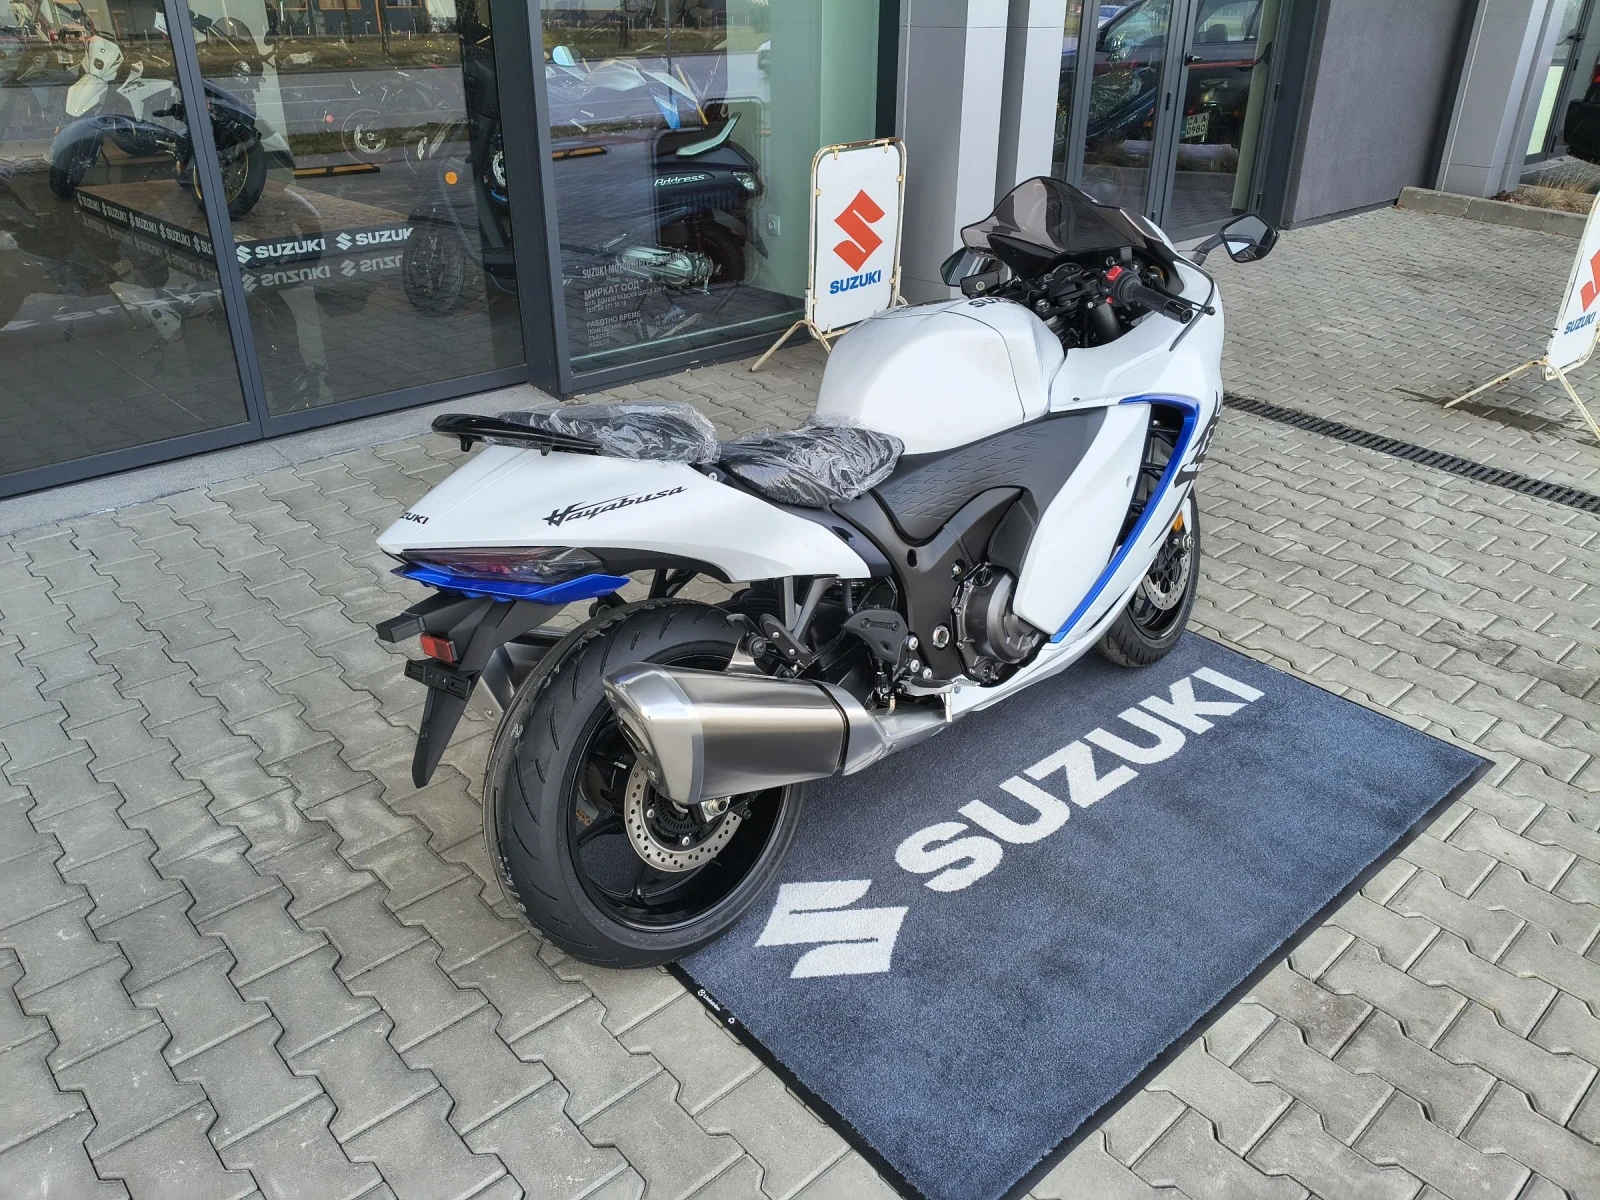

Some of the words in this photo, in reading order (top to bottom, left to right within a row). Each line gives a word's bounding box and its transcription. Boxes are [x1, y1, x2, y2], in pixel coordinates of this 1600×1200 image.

[1186, 124, 1206, 135] 0980
[654, 174, 706, 187] Address
[107, 205, 128, 223] SUZUKI
[135, 216, 158, 235] SUZUKI
[166, 228, 191, 248] SUZUKI
[255, 238, 327, 259] SUZUKI
[355, 227, 414, 246] SUZUK
[582, 264, 607, 279] SUZUKI
[829, 269, 882, 295] SUZUKI
[584, 284, 619, 298] МИРКАТ
[620, 280, 640, 292] ООД
[587, 315, 618, 328] РАБОТНО
[619, 311, 641, 321] ВРЕМЕ
[1564, 311, 1597, 335] SUZUKI
[542, 486, 689, 527] Hayabusa
[398, 512, 430, 525] ZUKI
[895, 666, 1266, 893] SUZUKI
